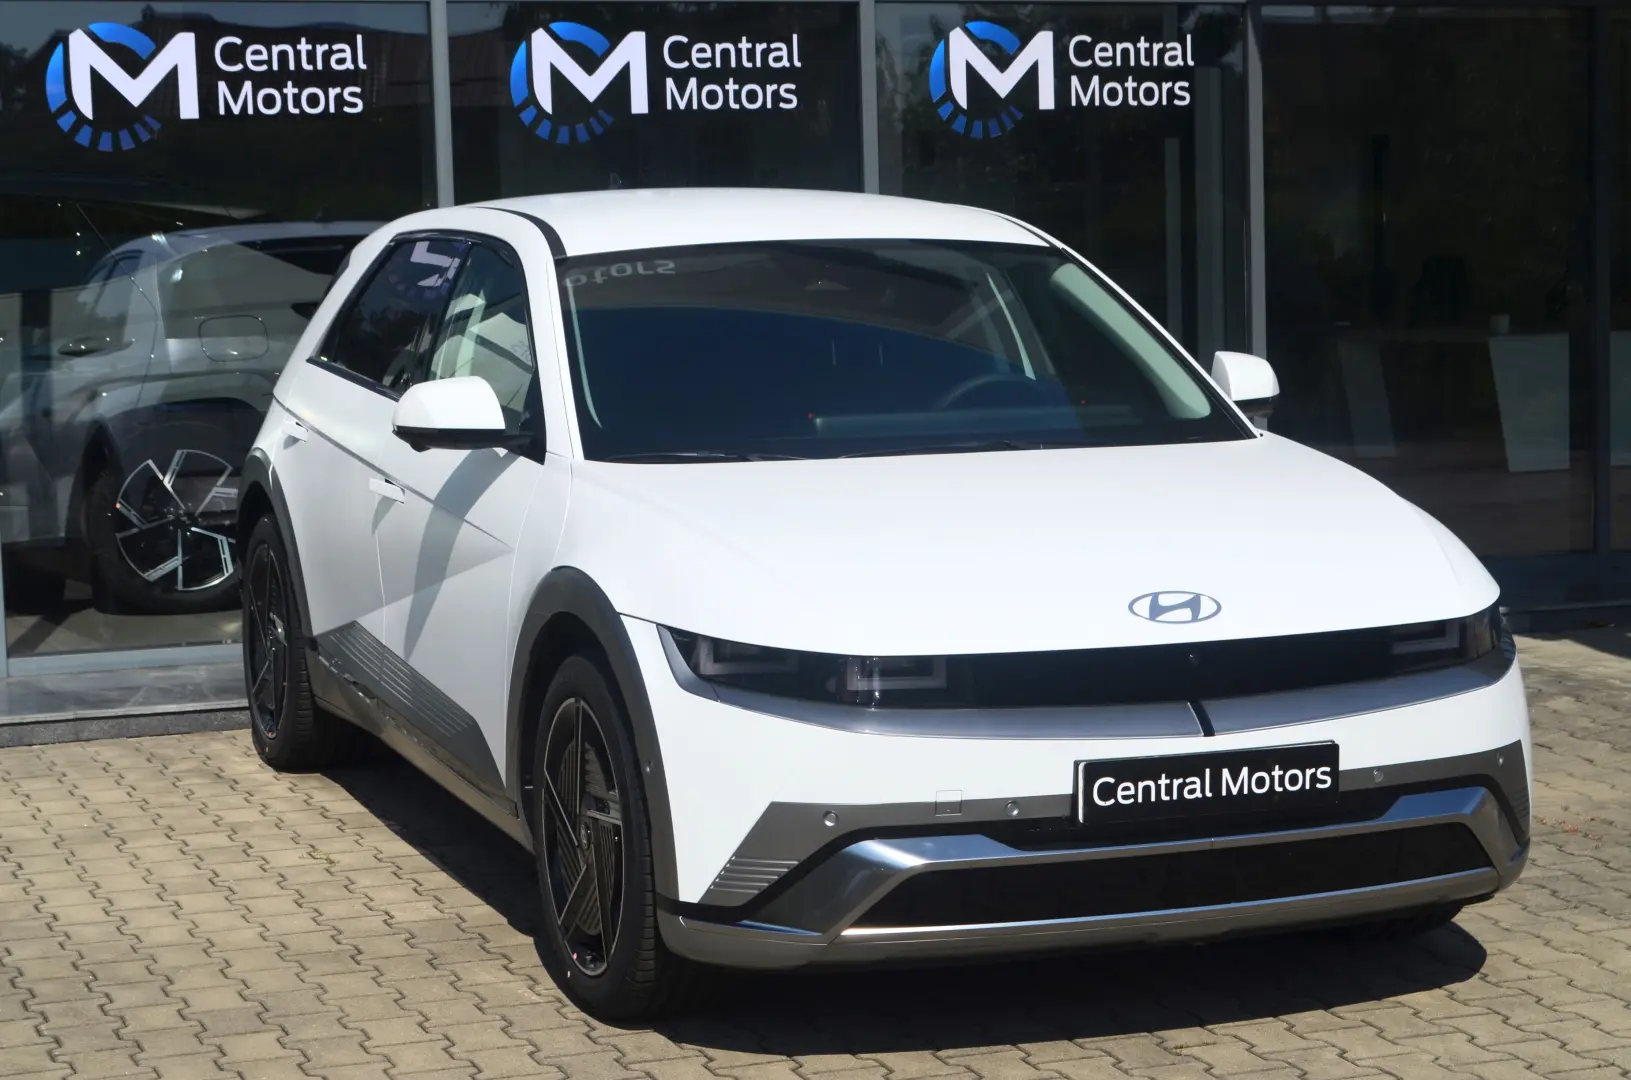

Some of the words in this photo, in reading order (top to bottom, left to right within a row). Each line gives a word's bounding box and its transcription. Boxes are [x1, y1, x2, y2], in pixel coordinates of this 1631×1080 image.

[214, 34, 367, 72] Central
[663, 33, 802, 69] Central
[1068, 34, 1195, 67] Central
[217, 80, 364, 116] Motors
[665, 77, 798, 110] Motors
[1070, 75, 1191, 107] Motors
[1092, 768, 1213, 807] Central
[1221, 764, 1332, 797] Motors
